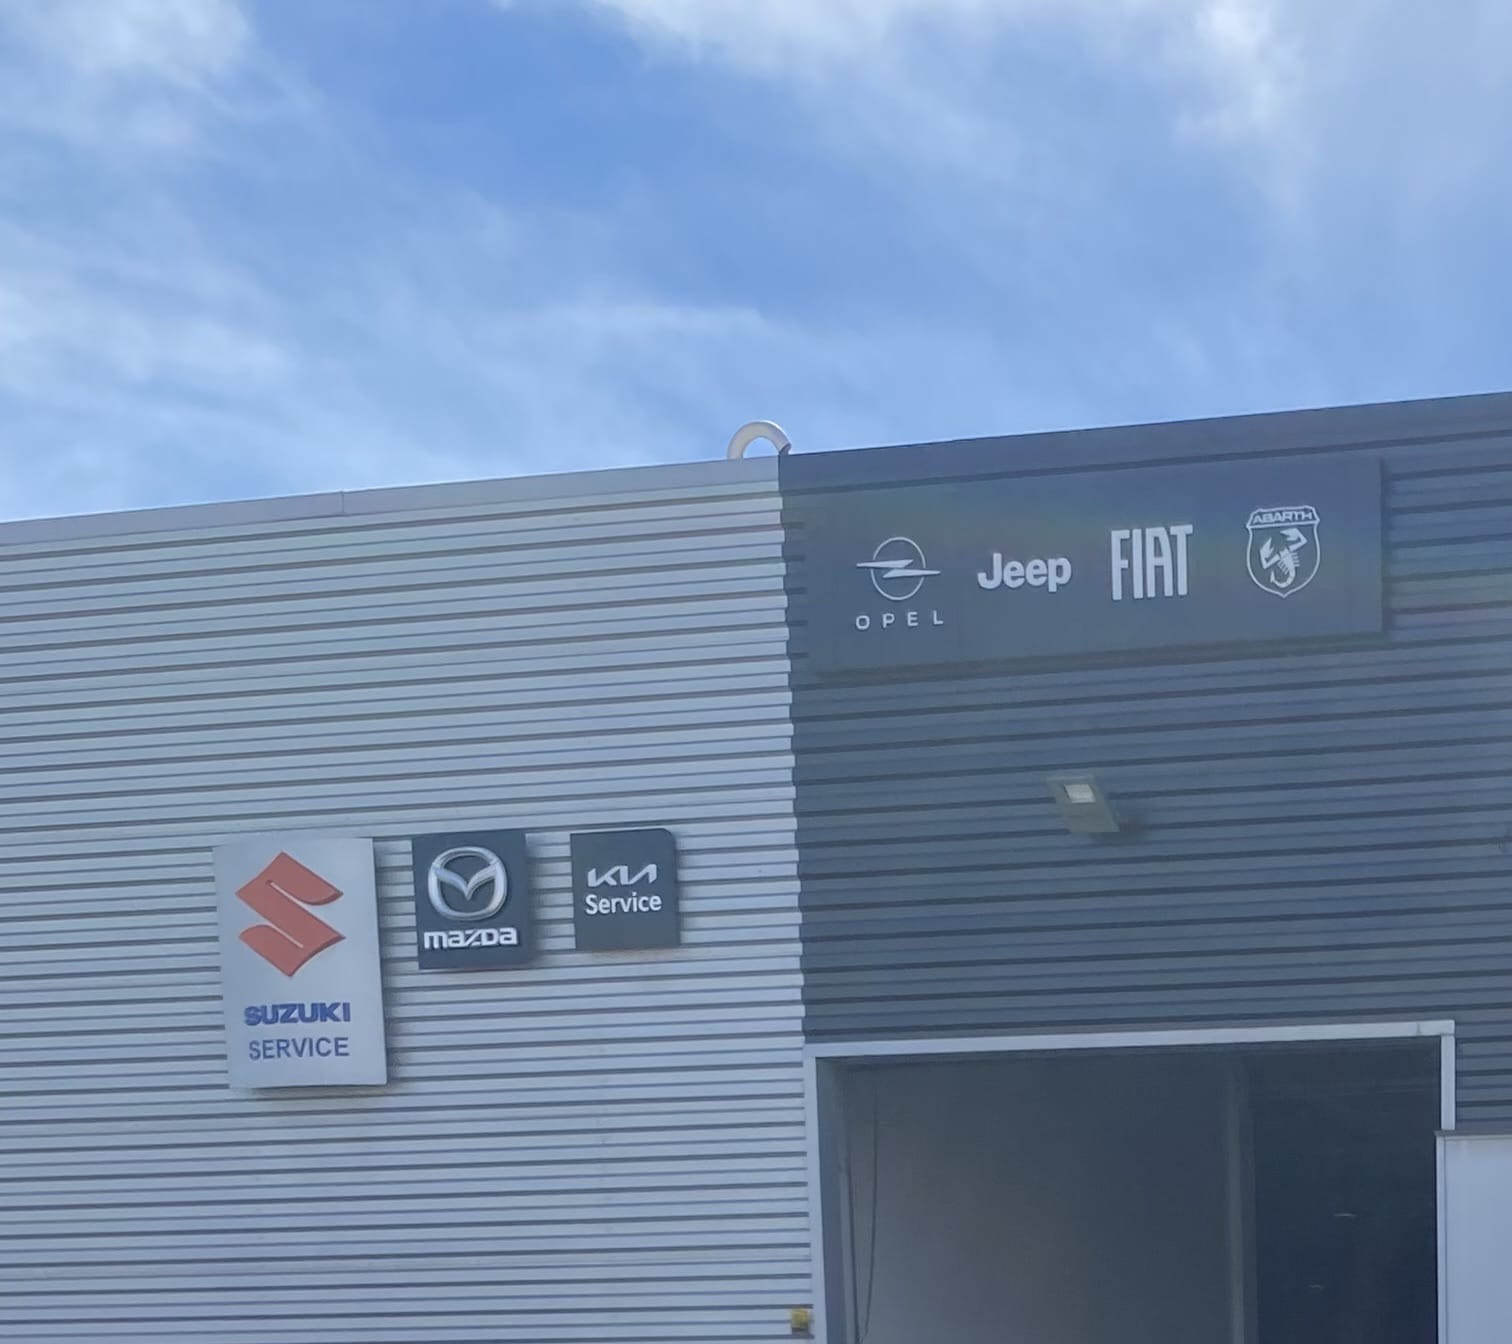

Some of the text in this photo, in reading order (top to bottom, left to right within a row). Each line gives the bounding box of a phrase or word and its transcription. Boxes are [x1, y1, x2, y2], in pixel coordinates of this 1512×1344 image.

[1252, 511, 1313, 524] ABARTH
[977, 553, 1073, 592] Jeep
[1110, 524, 1194, 601] FIAT
[855, 610, 944, 630] OPEL
[587, 863, 658, 888] KIA
[584, 892, 662, 915] Service
[243, 1001, 351, 1026] SUZUKI
[248, 1036, 350, 1061] SERVICE
